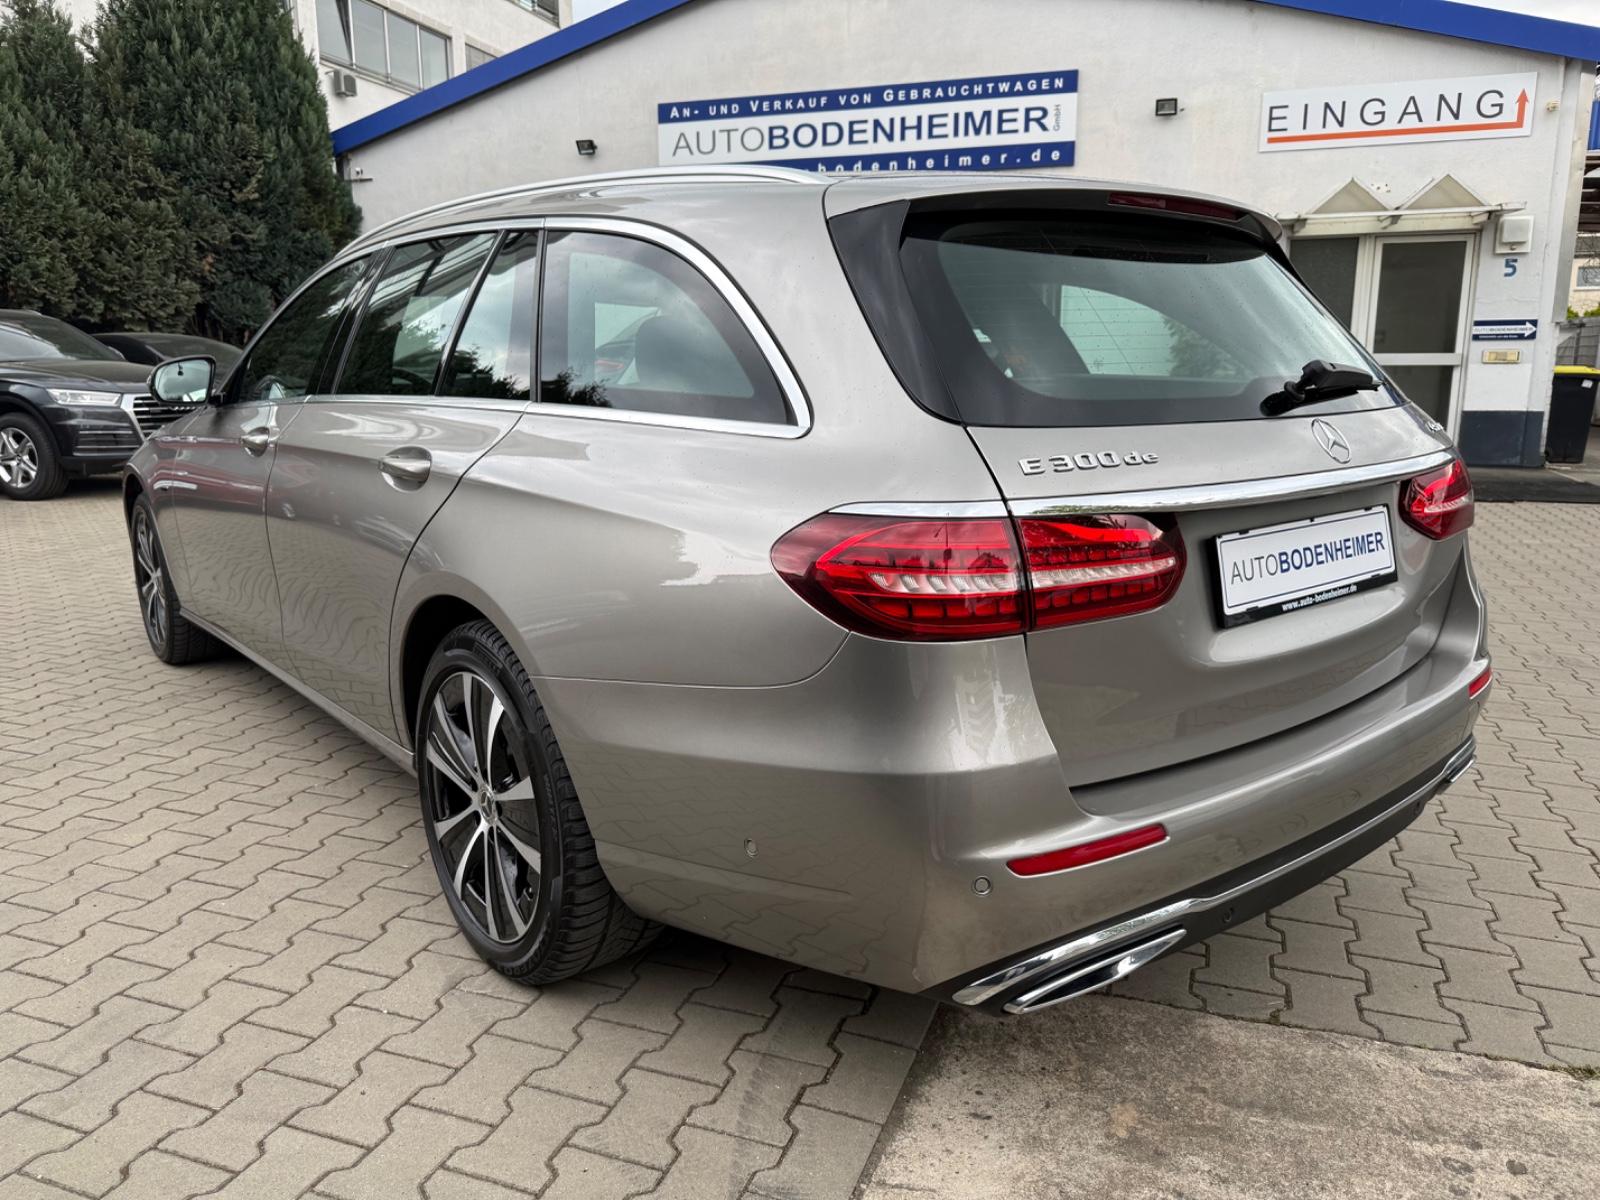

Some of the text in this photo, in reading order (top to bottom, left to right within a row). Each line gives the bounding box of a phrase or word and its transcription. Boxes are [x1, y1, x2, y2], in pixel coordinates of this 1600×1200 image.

[1052, 104, 1062, 131] GmbH
[1267, 89, 1505, 133] EINGANG
[672, 105, 1050, 158] AUTOBODENHEIMER
[1503, 258, 1519, 278] 5
[1019, 457, 1046, 476] E
[1230, 531, 1386, 585] AUTOBODENHEIMER
[1281, 584, 1358, 612] www.auto-bodenheimer.de
